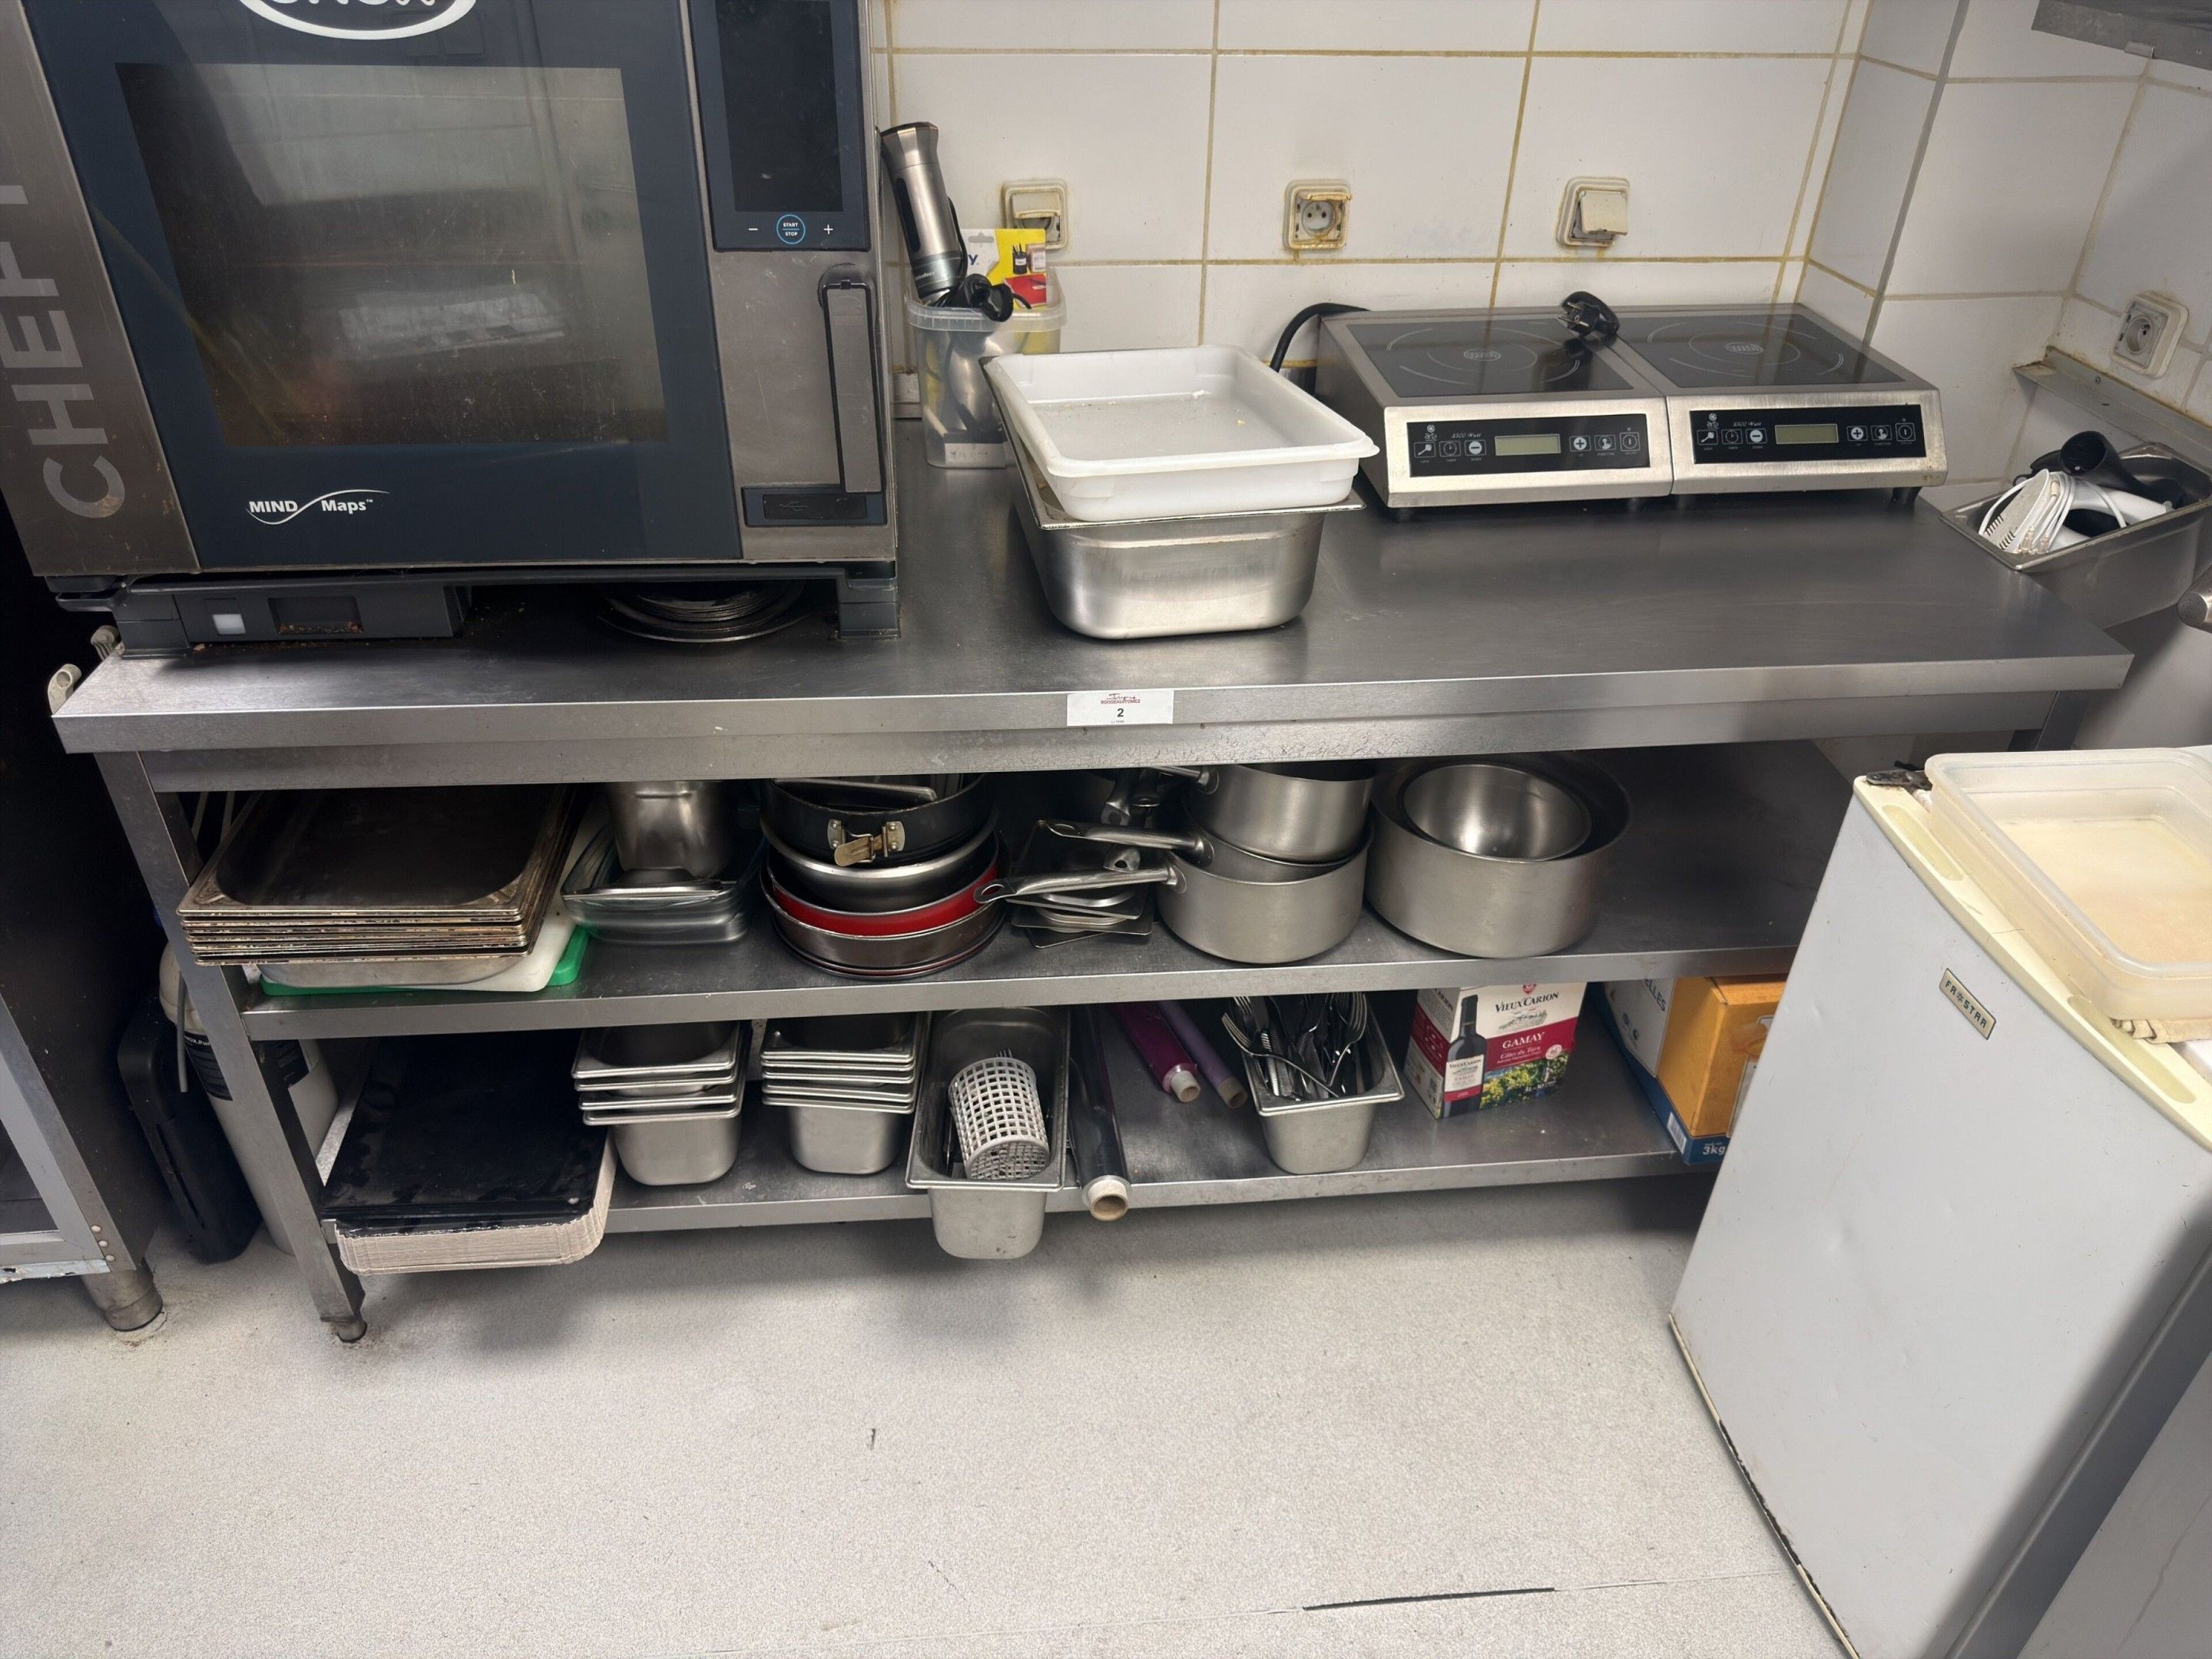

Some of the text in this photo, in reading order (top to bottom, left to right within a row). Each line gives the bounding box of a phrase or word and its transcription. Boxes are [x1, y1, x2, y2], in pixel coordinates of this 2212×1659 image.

[249, 500, 298, 513] MIND
[1117, 708, 1124, 717] 2
[1502, 1031, 1545, 1049] GAMAY
[1702, 1144, 1727, 1156] 3kg
